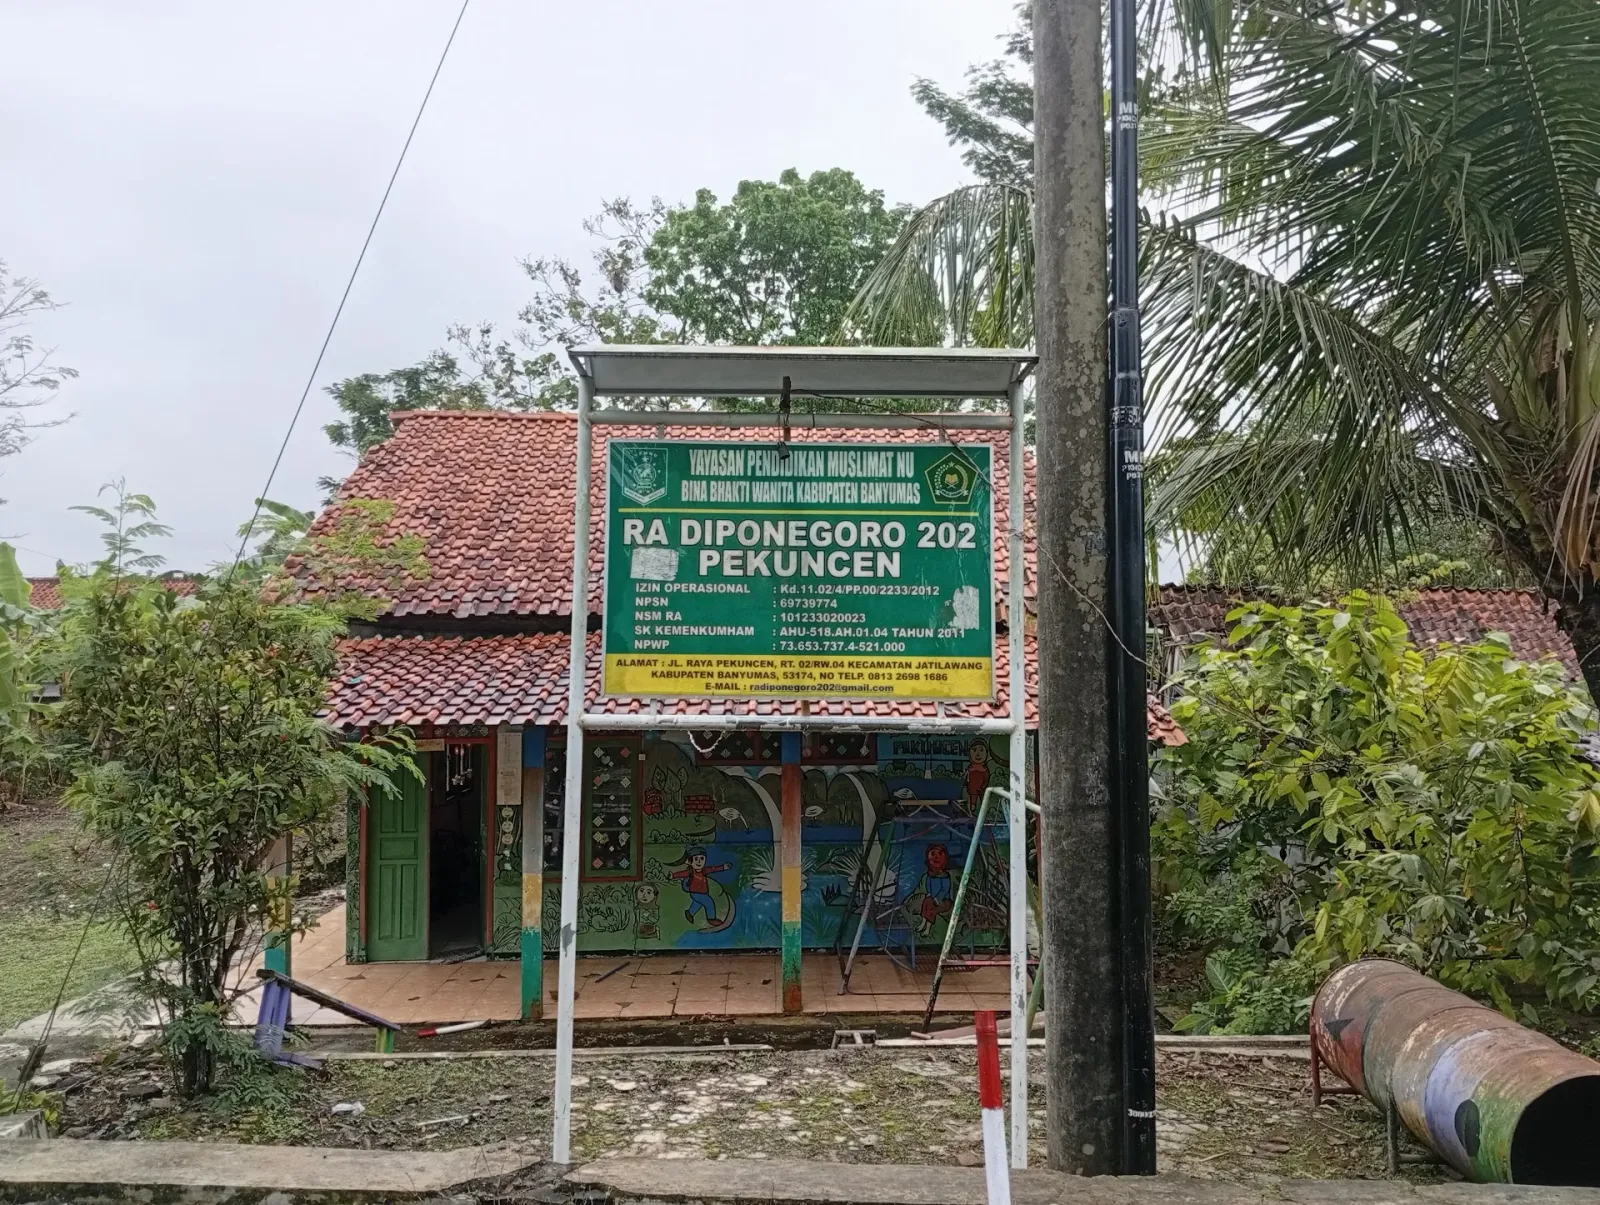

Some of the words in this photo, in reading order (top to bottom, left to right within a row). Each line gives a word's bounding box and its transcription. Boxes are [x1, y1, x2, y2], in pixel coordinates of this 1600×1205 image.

[689, 449, 745, 476] YAYASAN
[747, 450, 825, 477] PENDIDIKAN
[827, 451, 894, 477] MUSLIMAT
[896, 451, 915, 478] NU
[681, 480, 708, 501] BINA
[709, 480, 750, 502] BHAKTI
[751, 481, 794, 503] WANITA
[796, 481, 858, 503] KABUPATEN
[860, 482, 921, 504] BANYUMAS
[622, 518, 669, 546] RA
[680, 519, 906, 548] DIPONEGORO
[916, 521, 977, 549] 202
[698, 549, 901, 578] PEKUNCEN
[635, 583, 660, 592] IZIN
[664, 583, 751, 593] OPERASIONAL
[635, 597, 668, 607] NPSN
[780, 598, 838, 608] 69739774
[634, 611, 662, 621] NSM
[665, 611, 682, 621] RA
[780, 612, 866, 622] 101233020023
[634, 625, 651, 635] SK
[655, 626, 755, 636] KEMENKUMHAM
[779, 627, 888, 637] AHU-518.AH.01.04
[891, 628, 934, 638] TAHUN
[634, 640, 670, 650] NPWP
[780, 641, 906, 652] 73.653.737.4-521.000
[616, 659, 659, 667] ALAMAT
[667, 659, 683, 667] JL.
[686, 659, 713, 667] RAYA
[716, 660, 777, 669] PEKUNCEN,
[780, 660, 796, 668] RT.
[798, 660, 845, 669] 02/RW.04
[848, 661, 912, 669] KECAMATAN
[915, 661, 983, 670] JATILAWANG
[651, 670, 714, 679] KABUPATEN
[717, 671, 779, 680] BANYUMAS,
[782, 671, 816, 681] 53174,
[819, 672, 835, 680] NO
[837, 672, 865, 680] TELP.
[868, 672, 893, 681] 0813
[895, 673, 920, 681] 2698
[923, 673, 948, 681] 1686
[705, 682, 741, 691] E-MAIL
[749, 683, 894, 692] radiponegoro202@gmail.com
